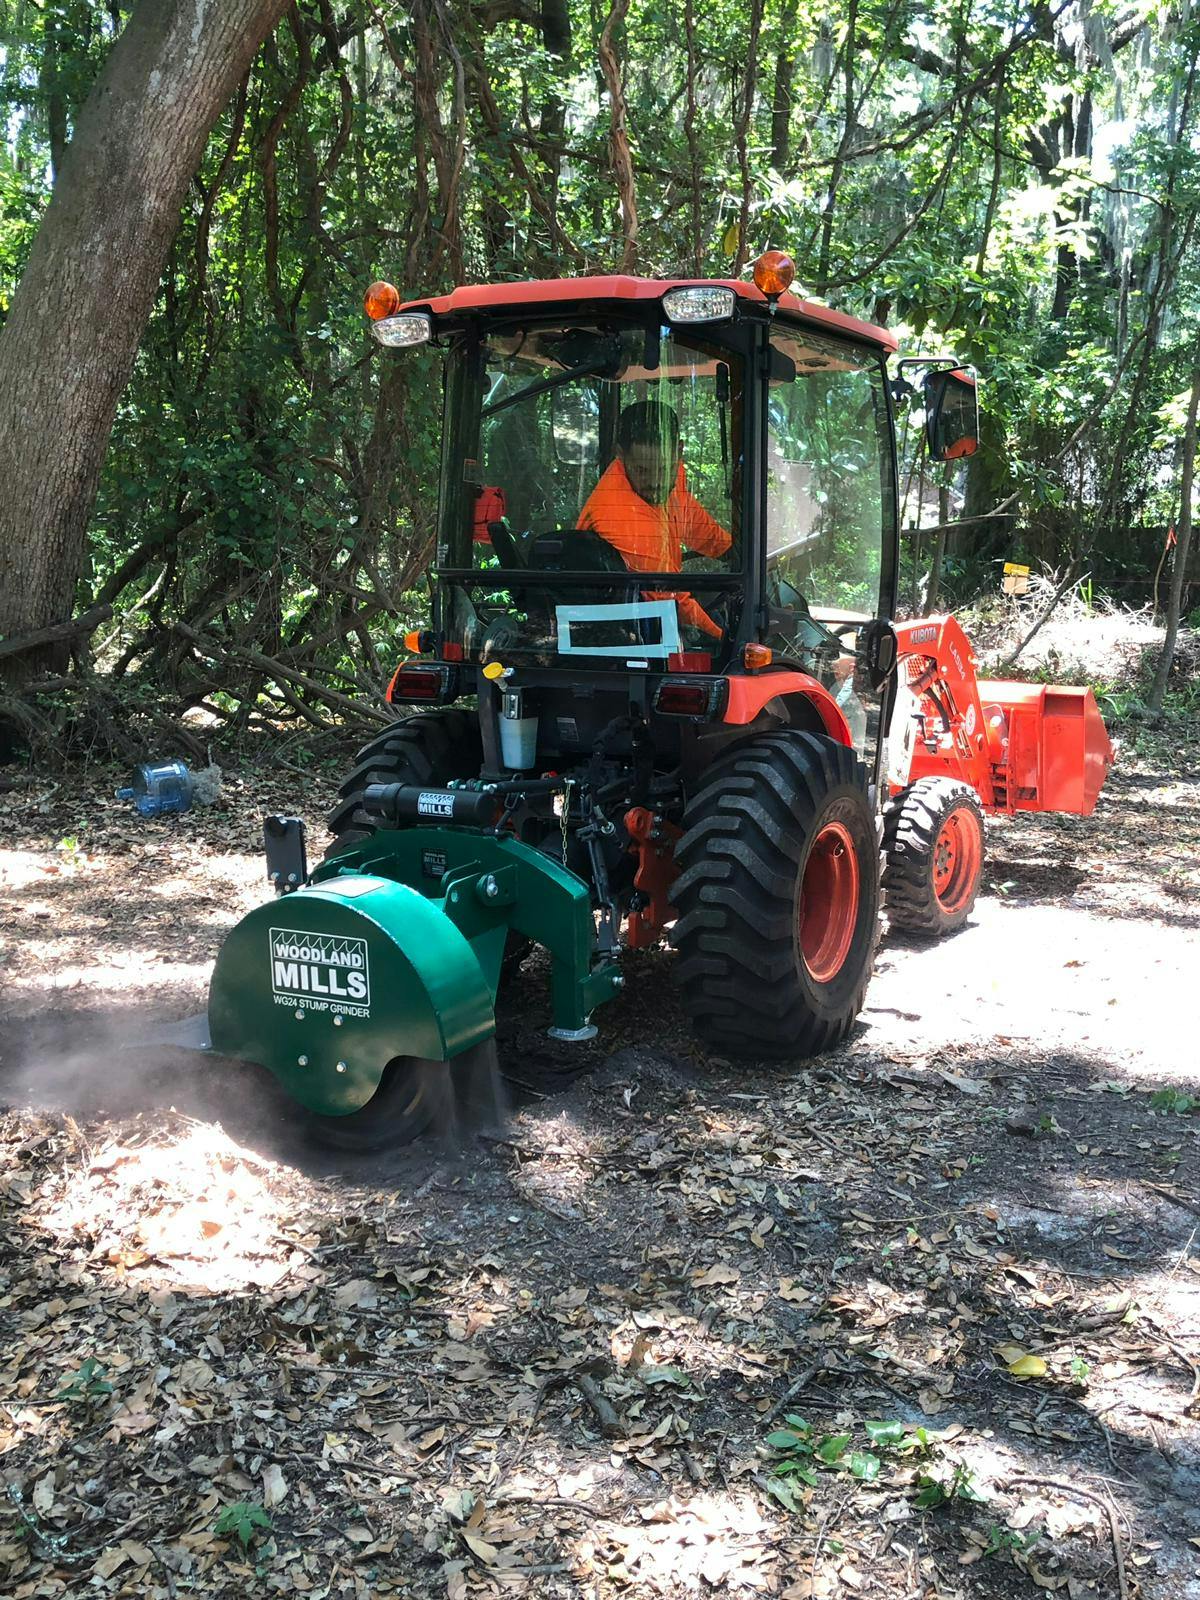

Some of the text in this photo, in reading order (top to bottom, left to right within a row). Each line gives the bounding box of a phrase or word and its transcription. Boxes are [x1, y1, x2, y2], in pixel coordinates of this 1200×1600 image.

[910, 627, 937, 644] KUBOTA
[419, 803, 451, 815] MILLS
[275, 943, 362, 967] WOODLAND
[274, 961, 367, 998] MILLS
[273, 995, 370, 1018] WG24 STUMP GRINDER
